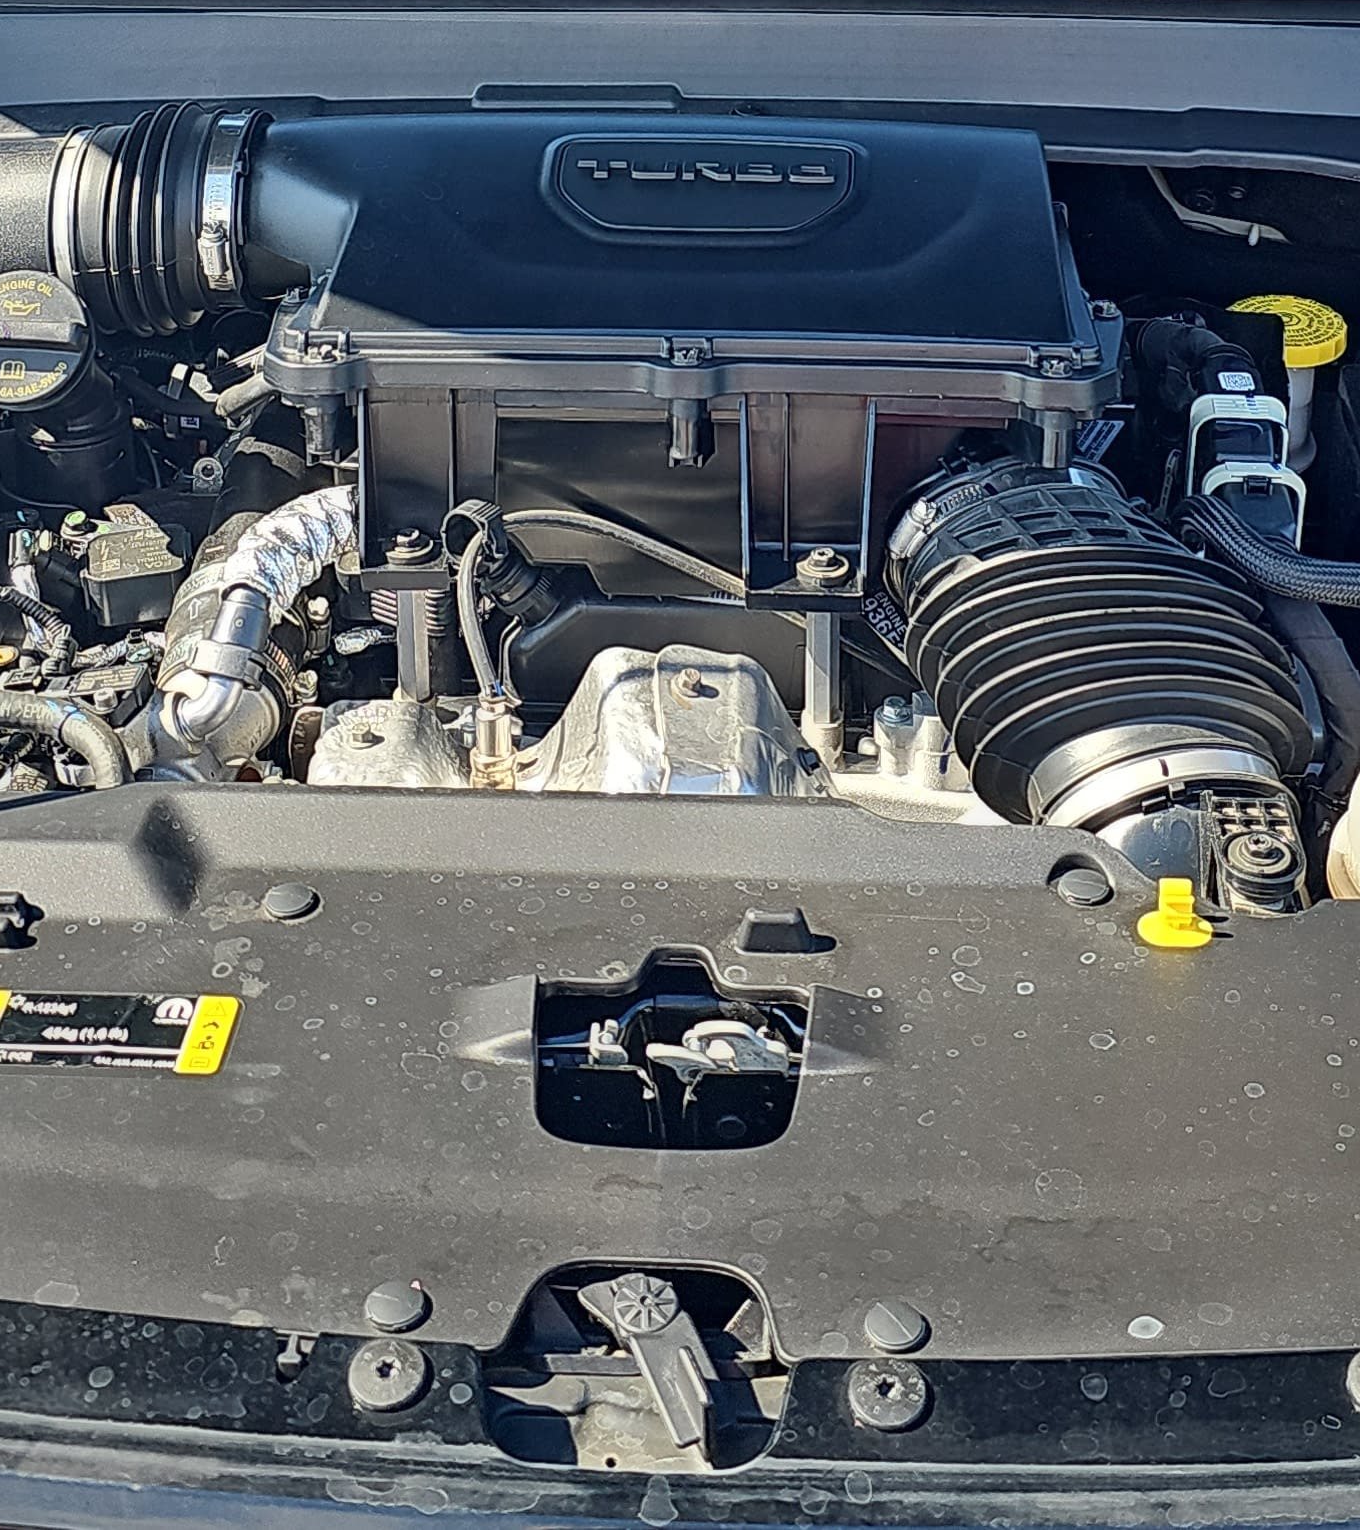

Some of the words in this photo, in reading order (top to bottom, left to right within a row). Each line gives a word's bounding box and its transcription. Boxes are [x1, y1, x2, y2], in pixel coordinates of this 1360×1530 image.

[577, 159, 835, 184] TURBO
[37, 282, 54, 298] OIL
[874, 591, 908, 635] ENGINE
